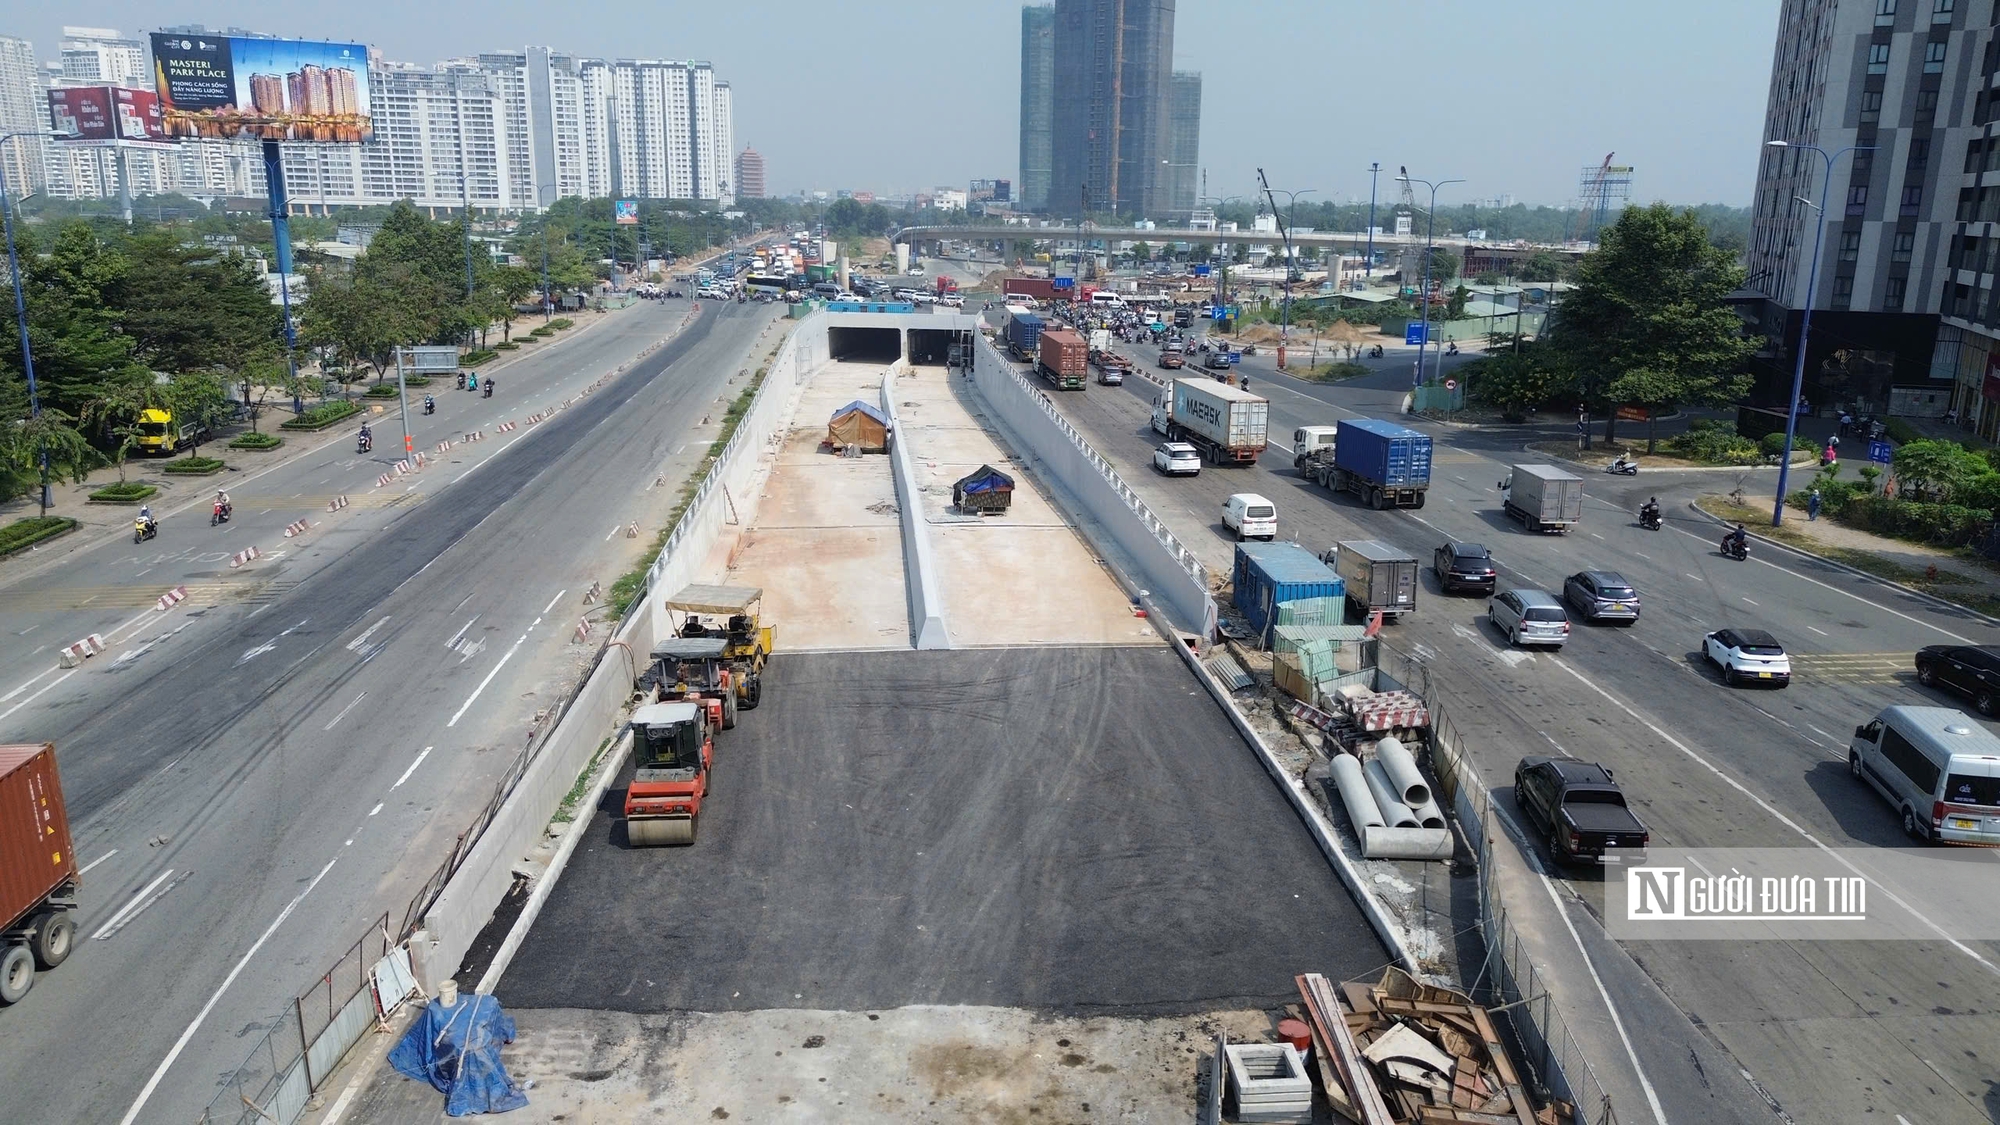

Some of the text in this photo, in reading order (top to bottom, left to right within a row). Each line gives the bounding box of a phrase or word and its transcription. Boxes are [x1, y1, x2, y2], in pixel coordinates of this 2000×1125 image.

[169, 60, 211, 69] MASTERI
[170, 68, 227, 78] PARK PLACE
[1186, 396, 1221, 428] MAERSK
